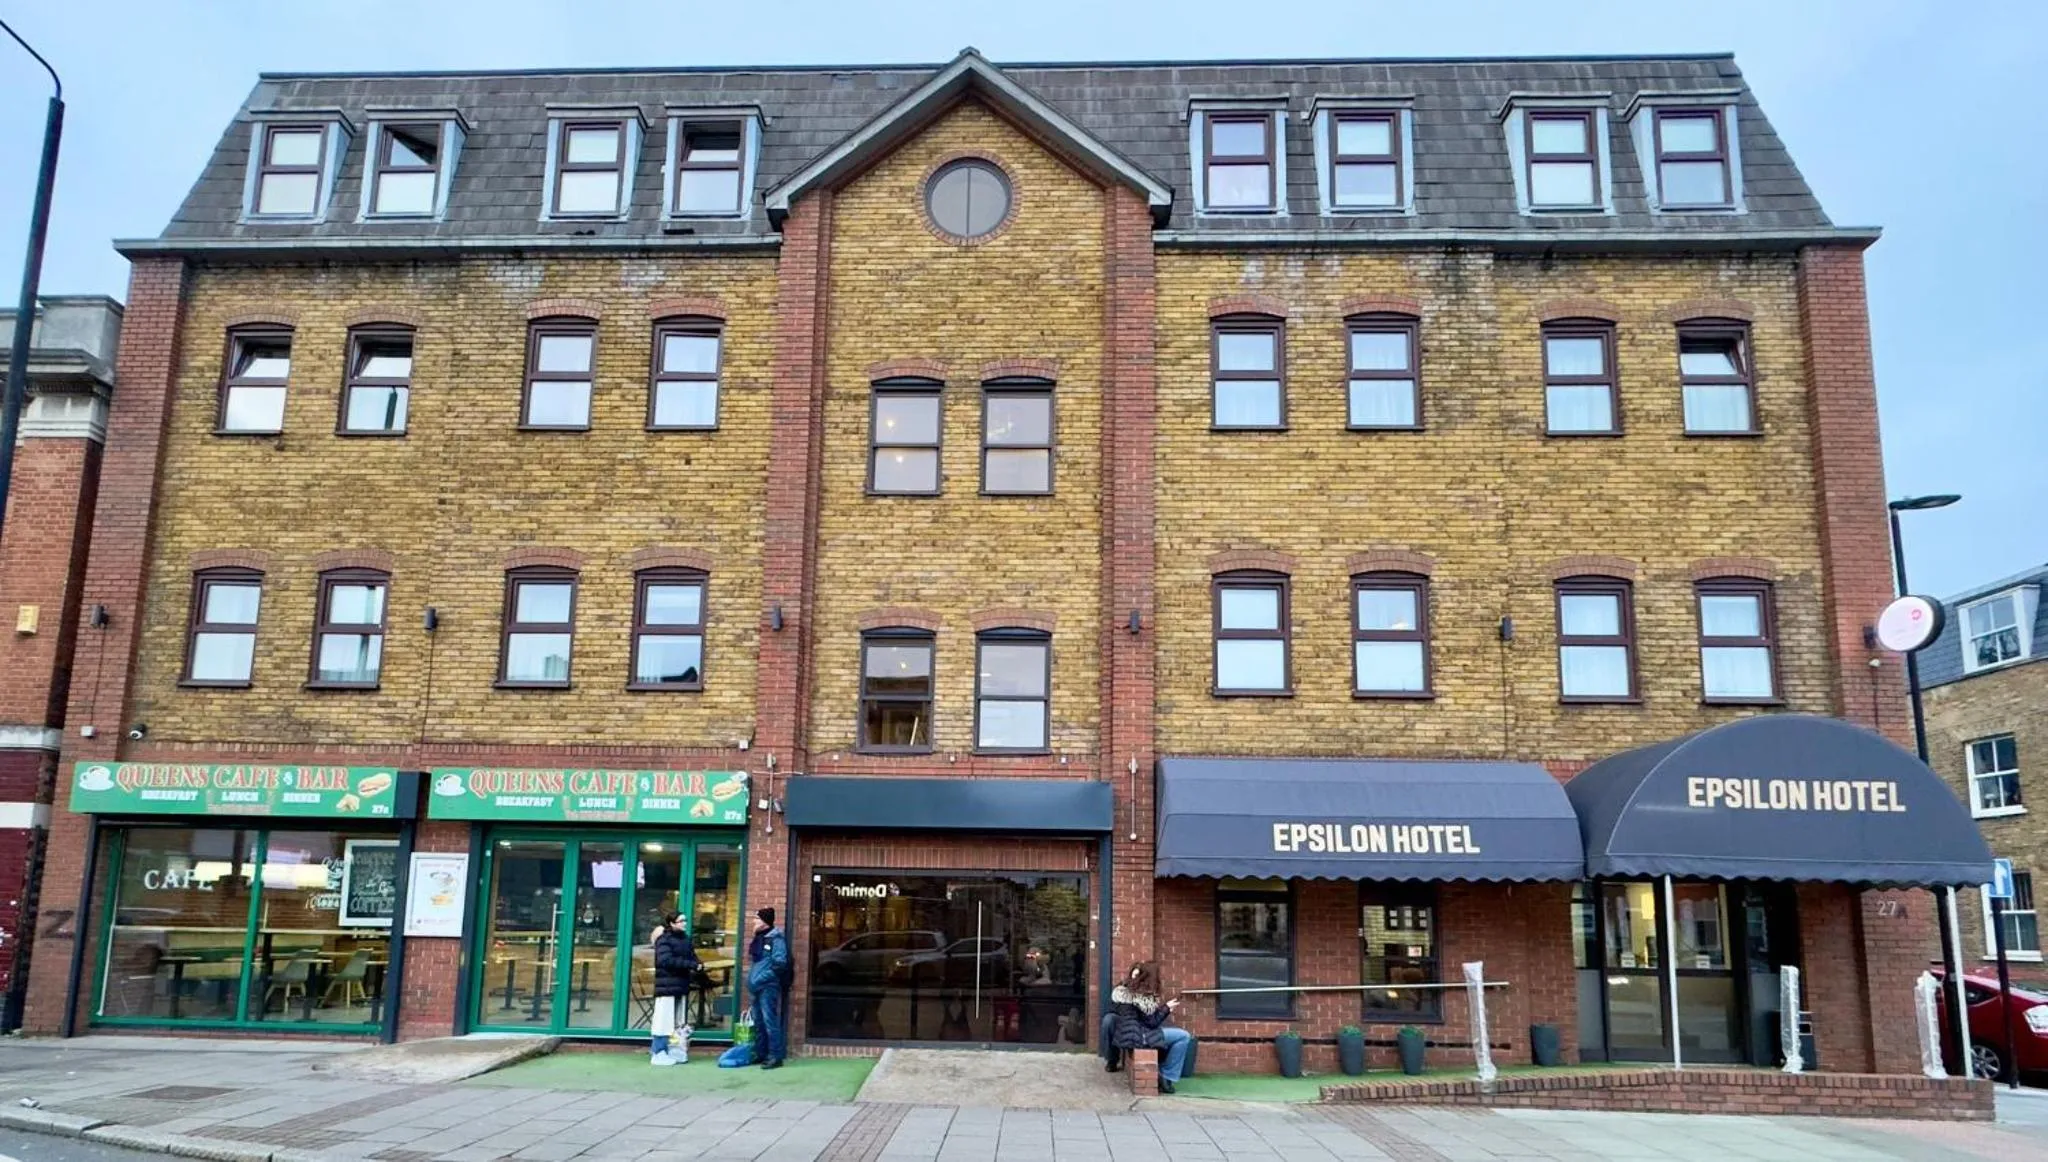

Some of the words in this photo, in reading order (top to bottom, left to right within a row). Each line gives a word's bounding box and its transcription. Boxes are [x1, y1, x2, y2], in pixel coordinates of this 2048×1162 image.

[116, 764, 209, 793] QUEENS
[213, 764, 280, 789] CAFE
[296, 766, 348, 790] BAR
[469, 769, 564, 799] QUEENS
[569, 770, 637, 795] CAFE
[653, 772, 708, 796] BAR
[141, 790, 199, 801] BREAKFAST
[221, 791, 259, 802] LUNCH
[495, 796, 554, 807] BREAKFAST
[579, 797, 617, 808] LUNCH
[642, 798, 681, 809] DINNER
[1687, 776, 1807, 810] EPSILON
[1812, 780, 1906, 812] HOTEL
[1273, 823, 1388, 853] EPSILON
[1392, 825, 1481, 854] HOTEL
